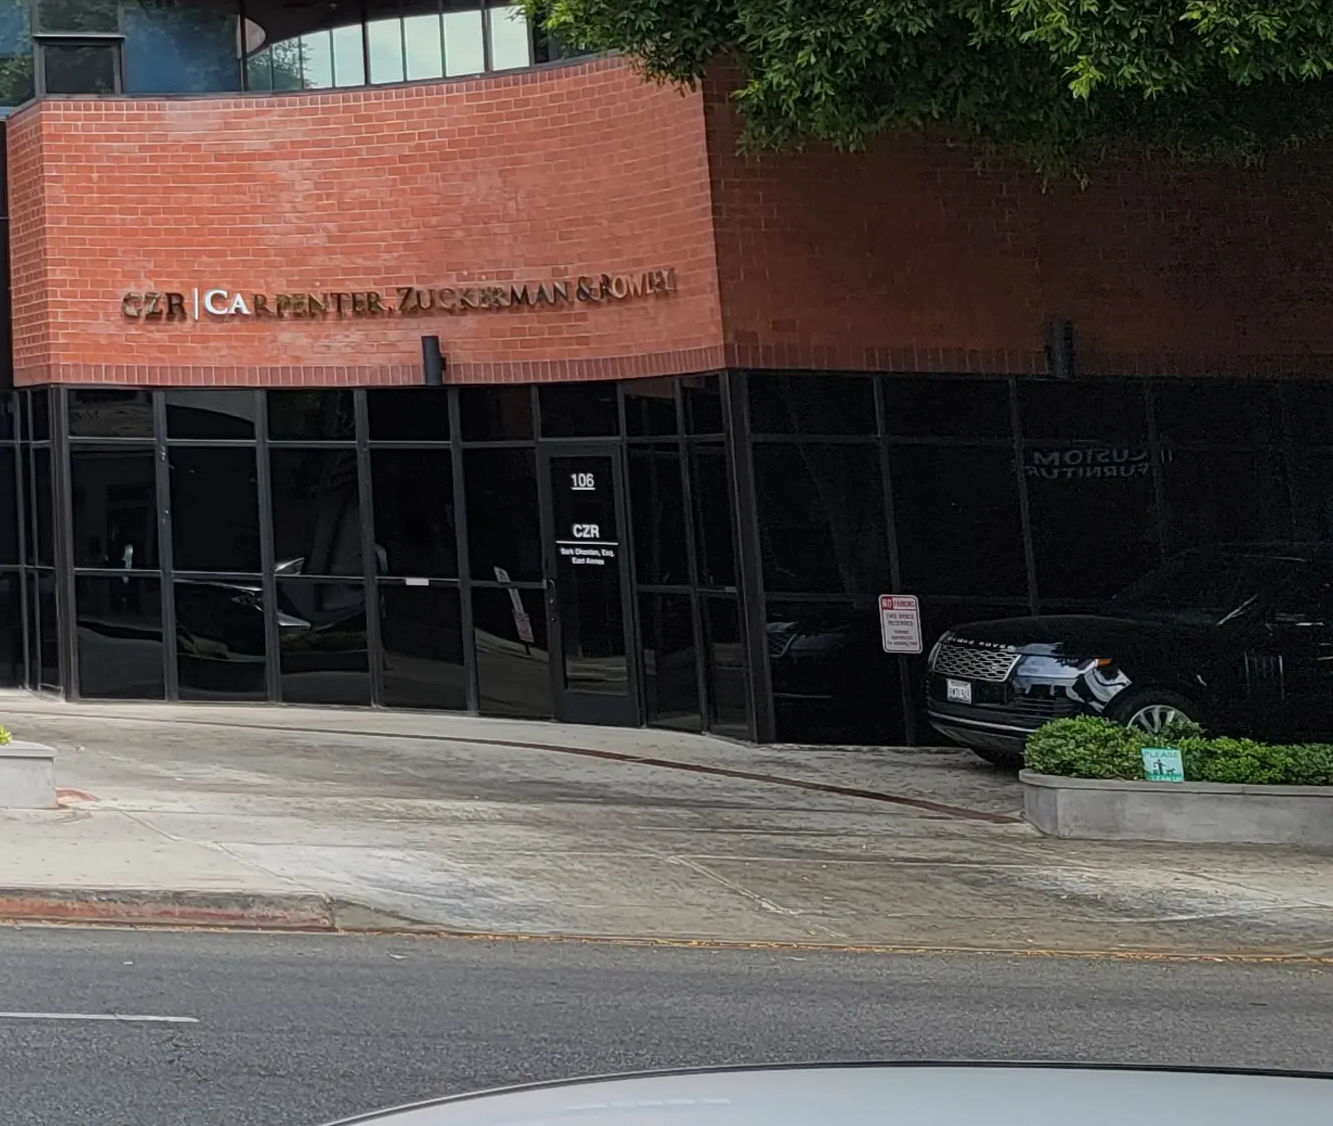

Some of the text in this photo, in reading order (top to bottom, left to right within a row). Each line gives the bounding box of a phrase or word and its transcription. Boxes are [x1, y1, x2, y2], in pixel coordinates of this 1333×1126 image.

[122, 291, 187, 320] CZR
[397, 281, 569, 315] ZUCKERMAN
[576, 274, 602, 302] &
[570, 473, 595, 487] 106
[573, 523, 600, 538] CZR
